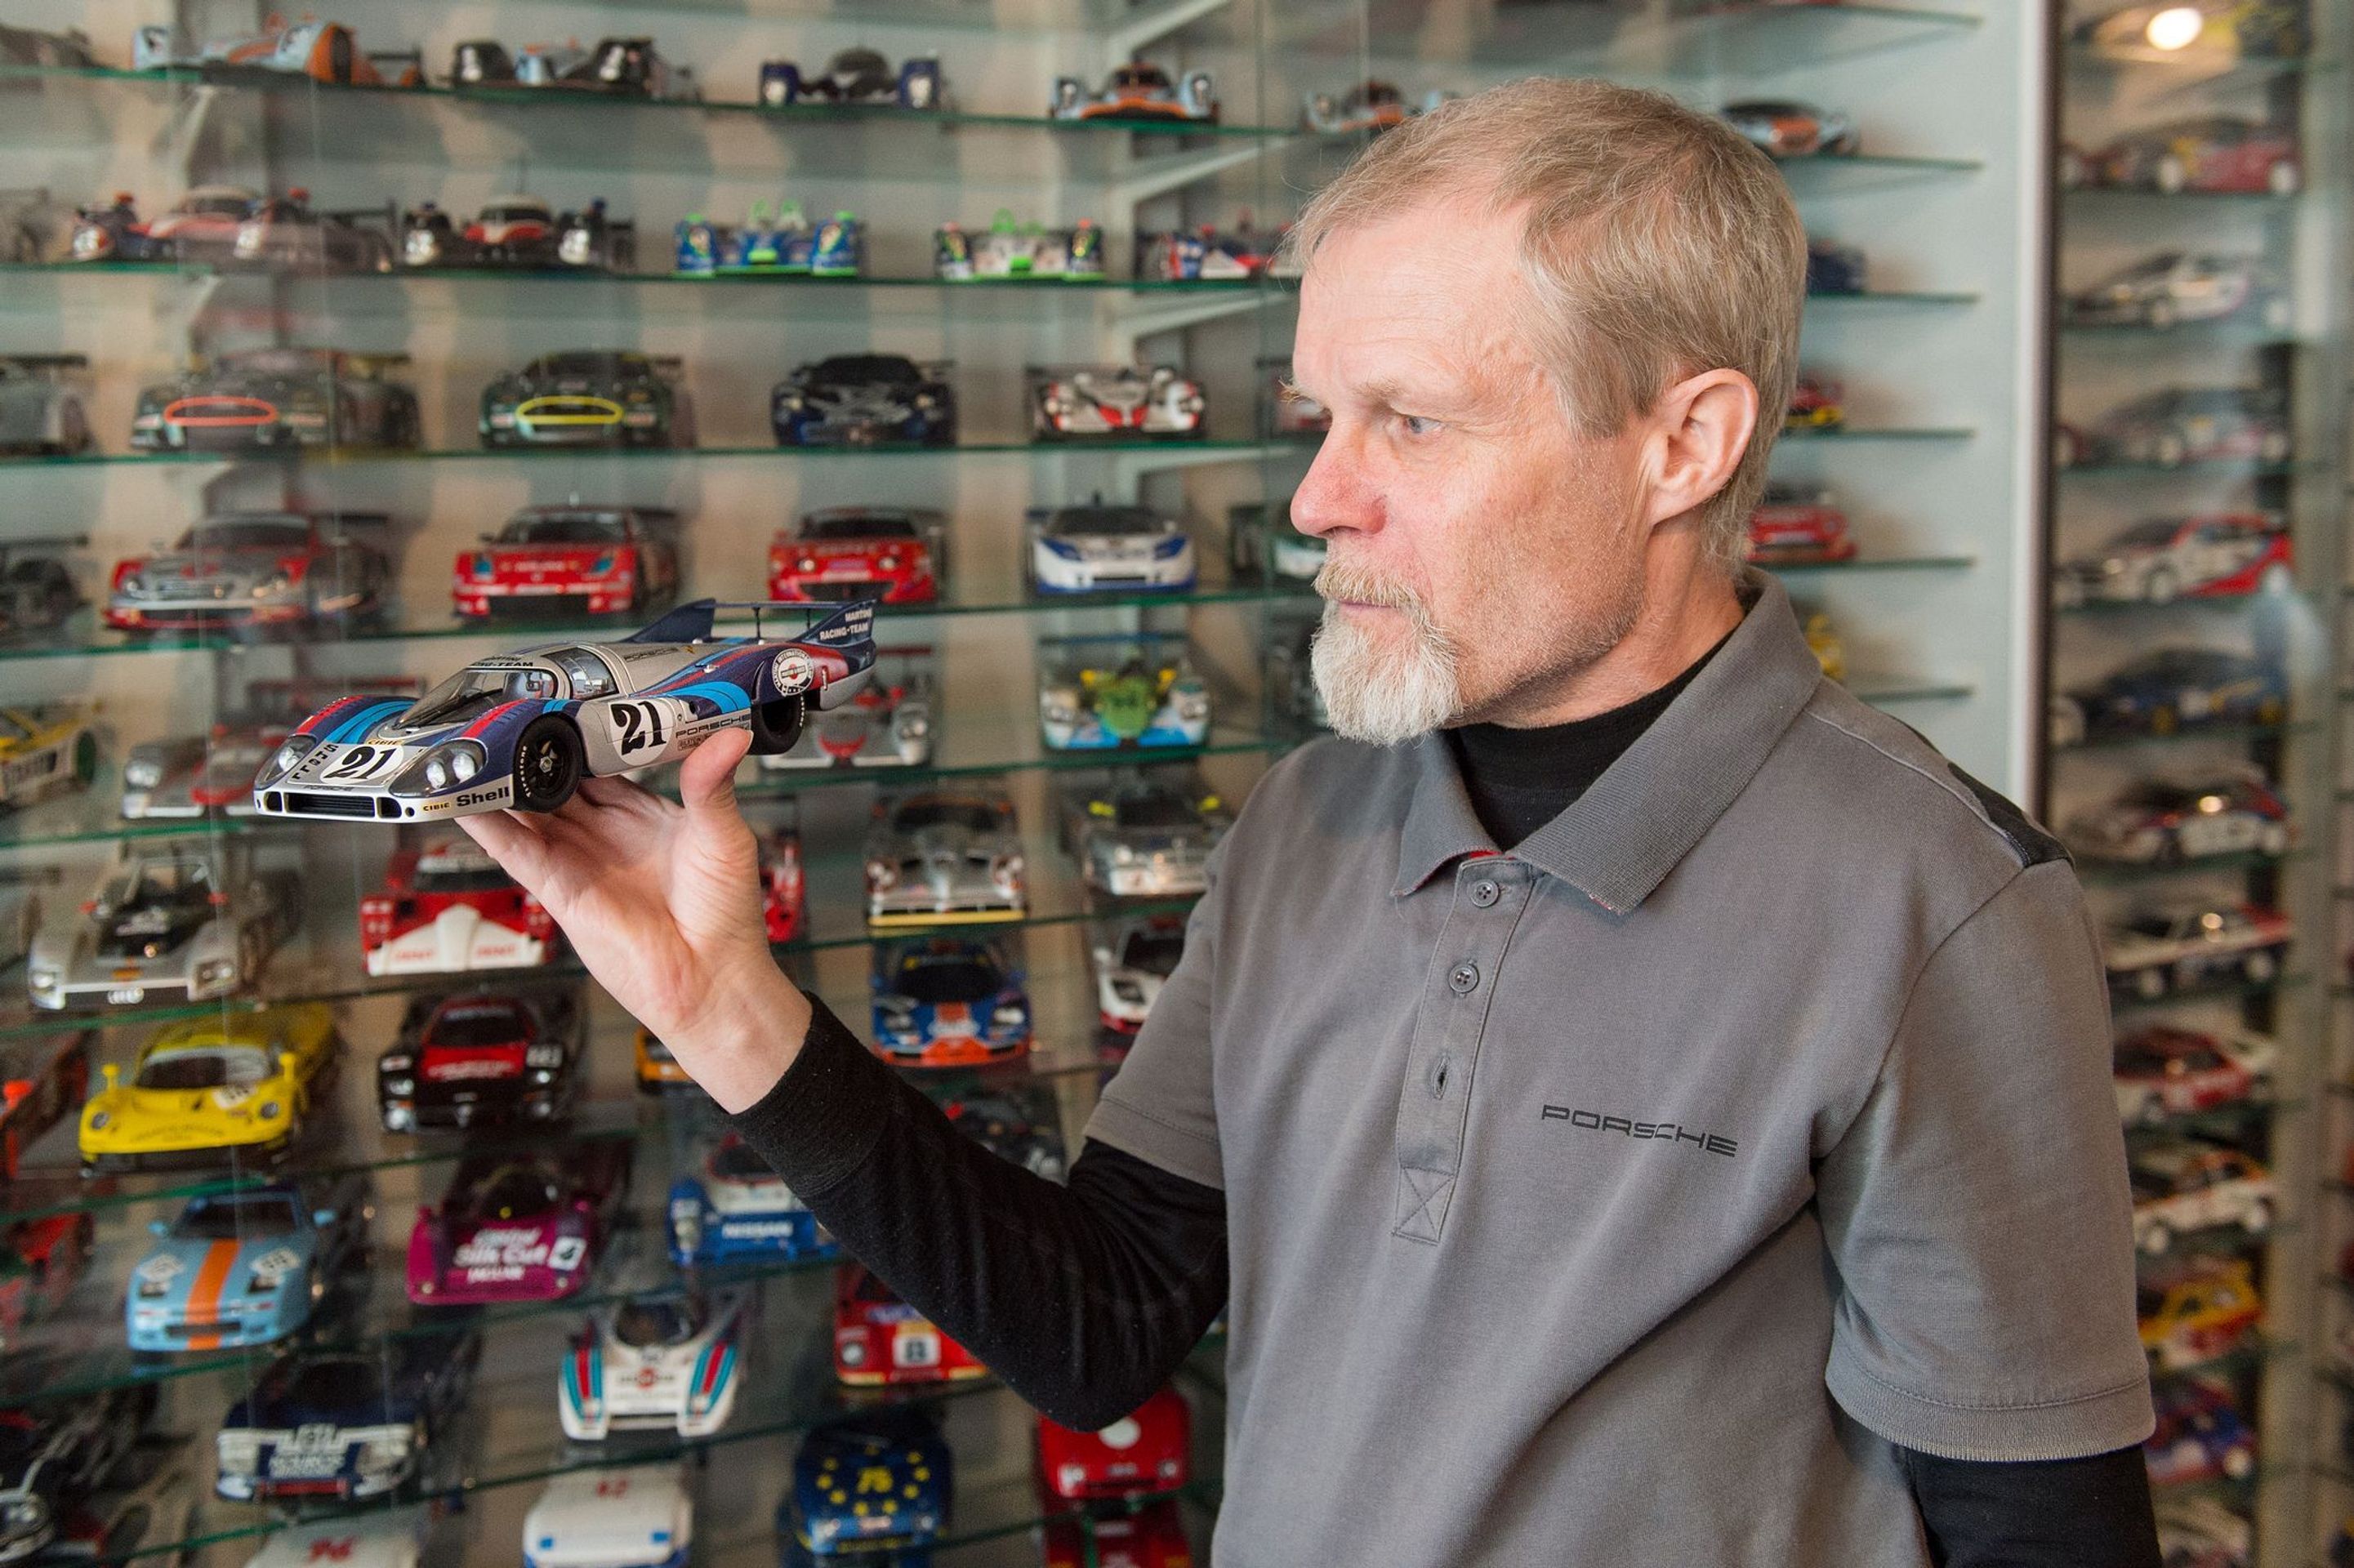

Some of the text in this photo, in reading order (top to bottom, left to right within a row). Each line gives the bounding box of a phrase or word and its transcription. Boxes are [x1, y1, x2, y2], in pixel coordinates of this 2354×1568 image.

[610, 701, 667, 756] 21
[675, 714, 751, 739] PORSCHE
[323, 746, 398, 780] 21
[457, 786, 510, 807] Shell
[1541, 1104, 1738, 1158] PORSCHE
